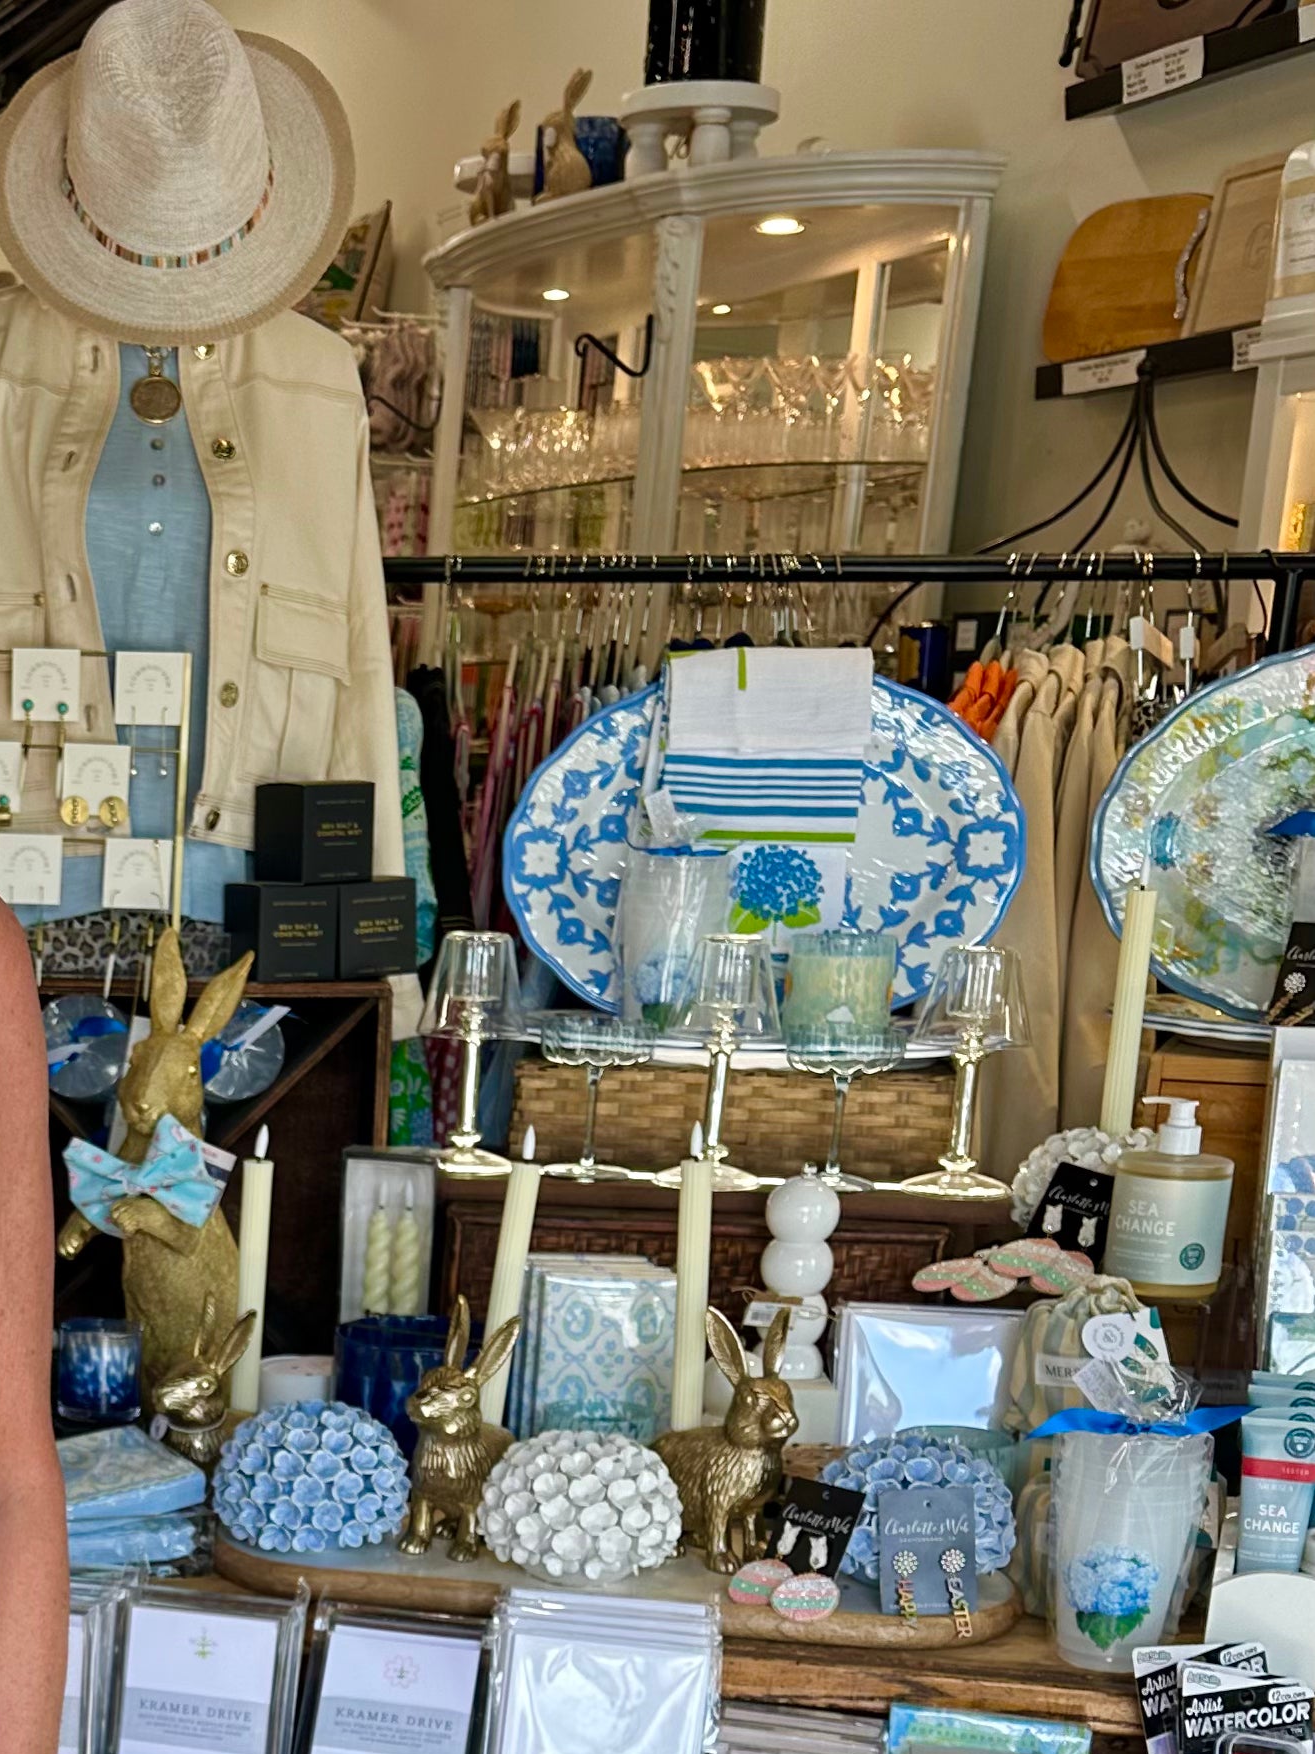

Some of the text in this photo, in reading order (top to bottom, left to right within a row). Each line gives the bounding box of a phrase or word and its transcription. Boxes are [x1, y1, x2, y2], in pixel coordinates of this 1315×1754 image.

[1128, 1199, 1159, 1217] SEA
[1115, 1215, 1177, 1237] CHANGE
[1258, 1504, 1288, 1519] SEA
[1243, 1517, 1301, 1534] CHANGE
[946, 1576, 973, 1639] EASTER
[140, 1699, 252, 1722] KRAMER DRIVE
[1186, 1695, 1224, 1716] Artist
[336, 1706, 454, 1732] KRAMER DRIVE
[1185, 1701, 1311, 1738] WATERCOLOR
